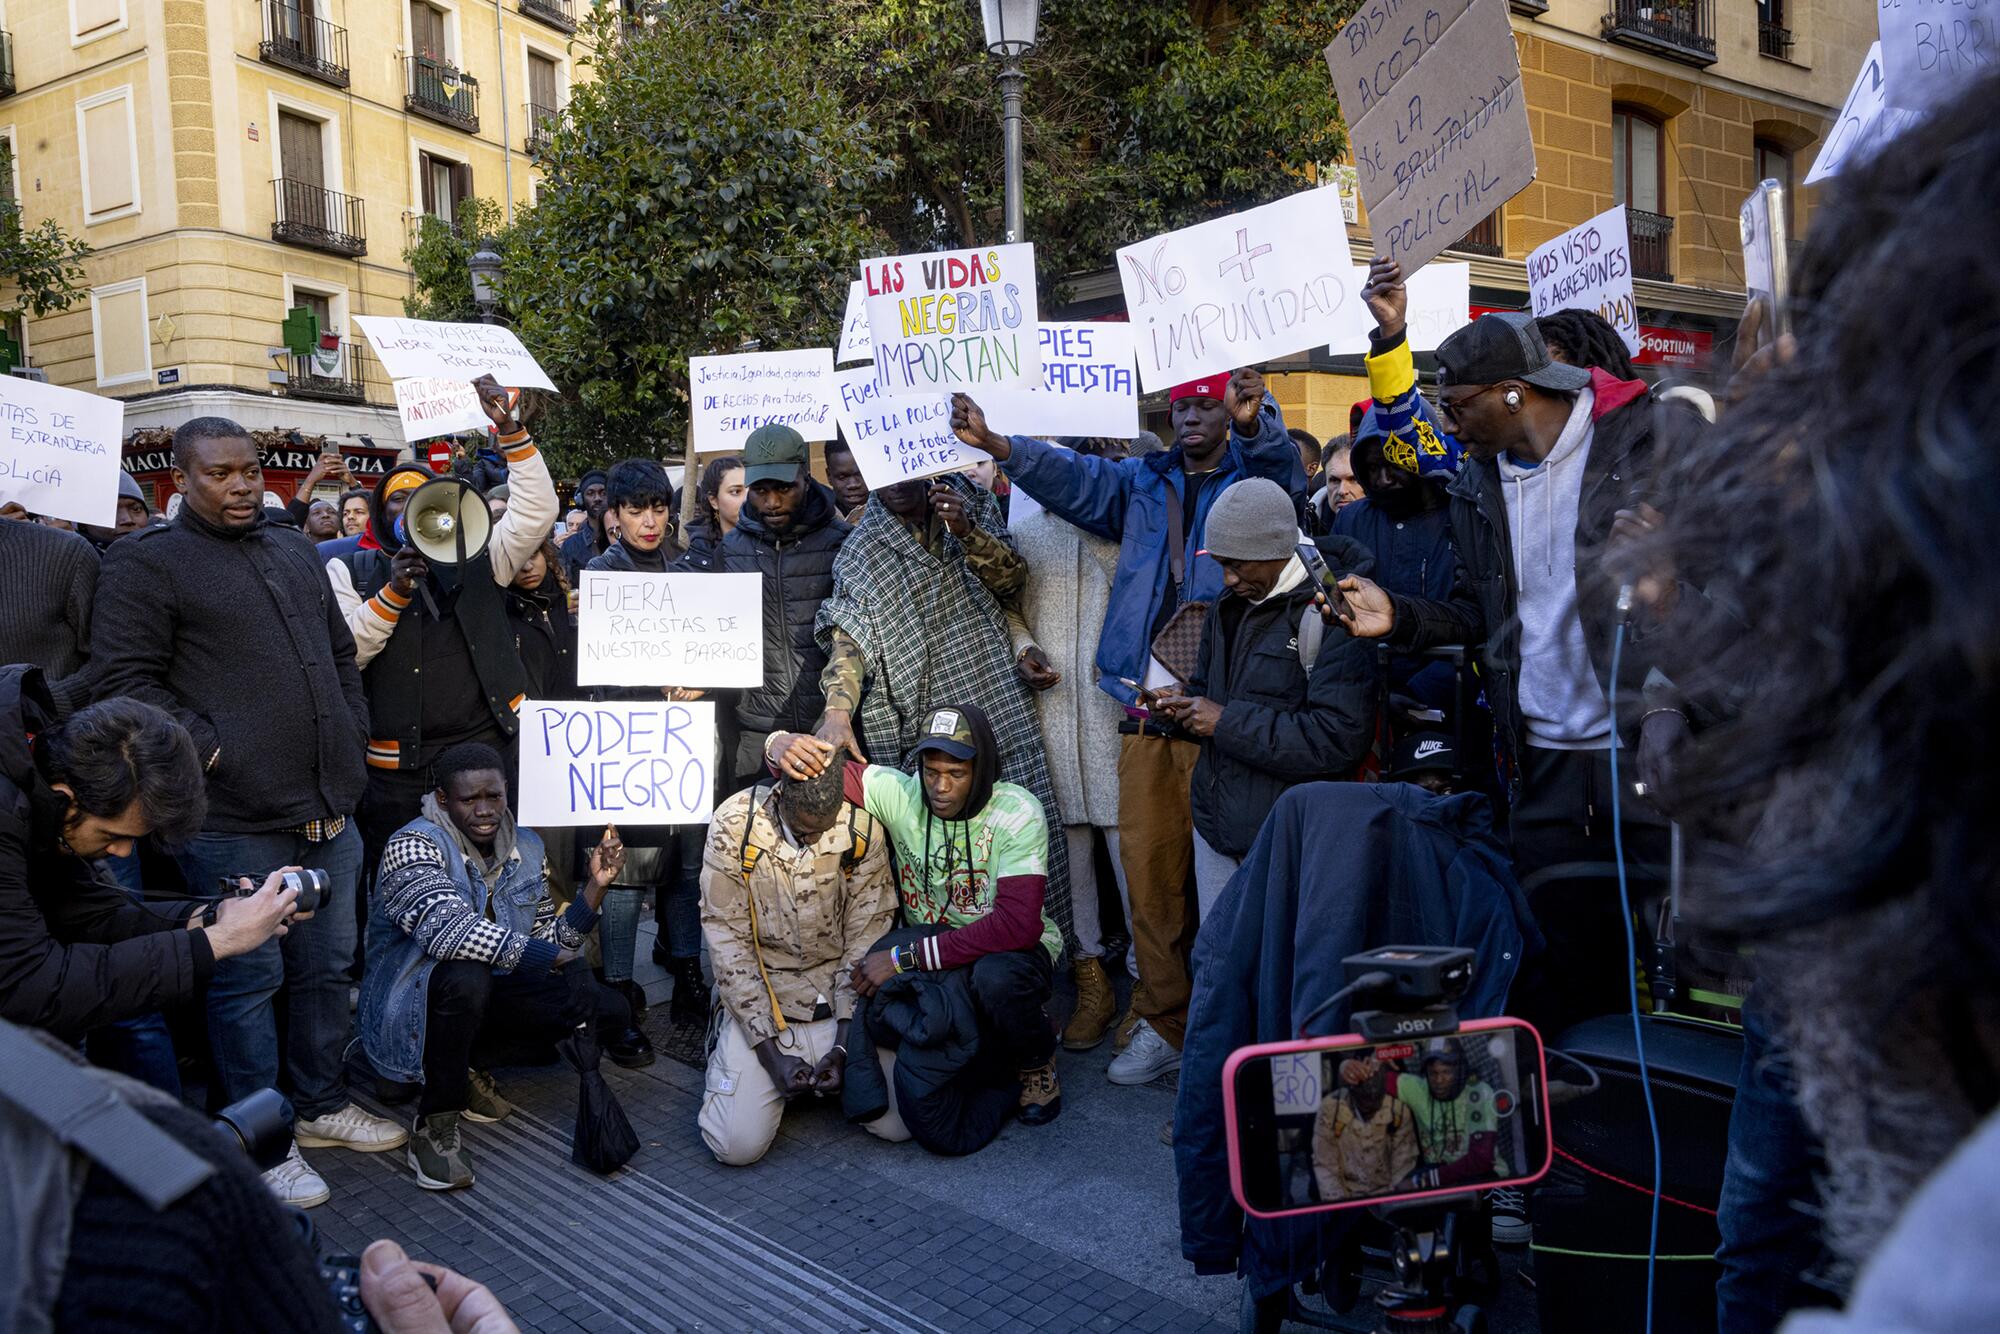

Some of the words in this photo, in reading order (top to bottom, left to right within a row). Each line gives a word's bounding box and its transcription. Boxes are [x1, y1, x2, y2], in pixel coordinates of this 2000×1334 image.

[1358, 9, 1441, 110] ACOSO
[1360, 143, 1387, 182] DE
[1395, 95, 1422, 144] LA
[865, 261, 904, 297] LAS
[921, 251, 1001, 290] VIDAS
[1529, 250, 1558, 287] HEMOS
[899, 283, 1022, 338] NEGRAS
[875, 334, 1019, 388] IMPORTAN
[1639, 332, 1695, 355] SPORTIUM
[50, 412, 75, 430] DE
[855, 419, 878, 440] DE
[881, 414, 901, 432] LA
[901, 449, 959, 474] PARTES
[589, 578, 676, 614] FUERA
[717, 616, 738, 632] DE
[587, 640, 672, 661] NUESTROS
[536, 706, 692, 758] PODER
[1420, 740, 1443, 752] NIKE
[569, 757, 705, 813] NEGRO
[1393, 1018, 1435, 1034] JOBY
